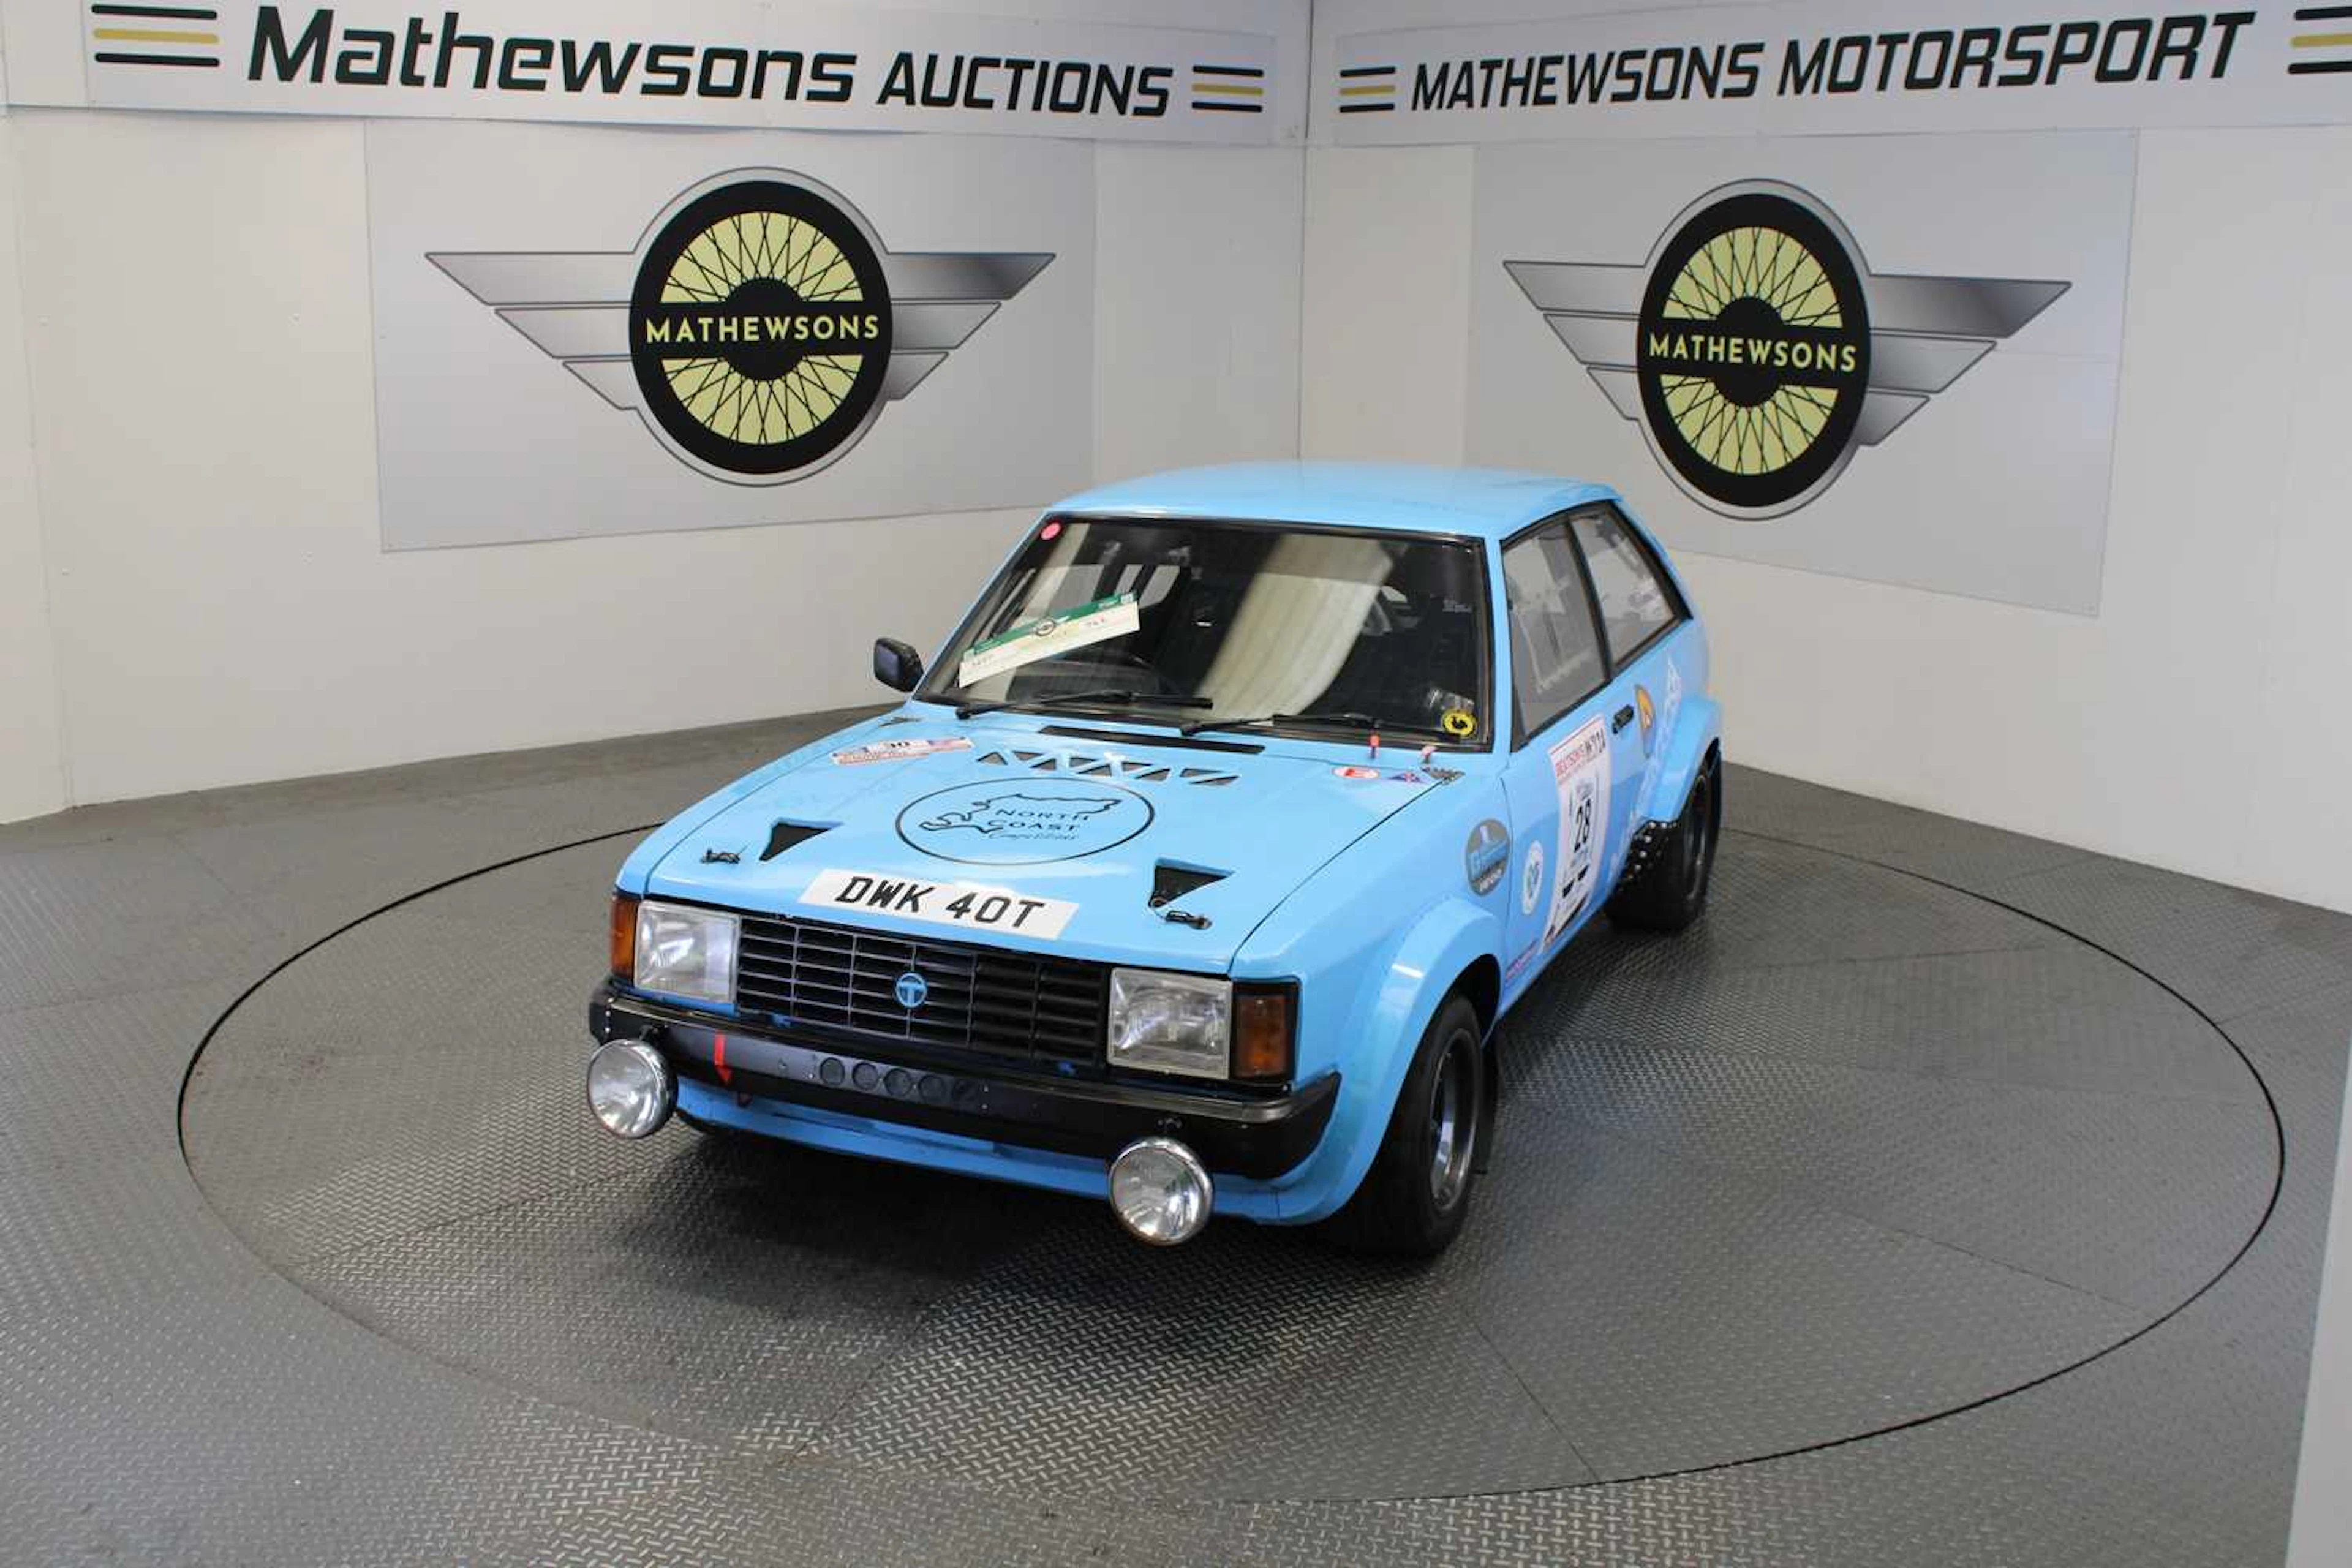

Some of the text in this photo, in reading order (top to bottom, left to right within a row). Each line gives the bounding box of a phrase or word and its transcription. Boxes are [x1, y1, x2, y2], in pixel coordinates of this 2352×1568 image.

[247, 5, 1174, 118] Mathewsons AUCTIONS
[1411, 11, 2257, 111] MATHEWSONS MOTORSPORT
[645, 314, 880, 343] MATHEWSONS
[1649, 333, 1857, 372] MATHEWSONS
[987, 820, 1080, 832] COAST
[995, 809, 1090, 822] NORTH
[1574, 797, 1591, 853] 28
[834, 876, 1045, 927] DWK 40T
